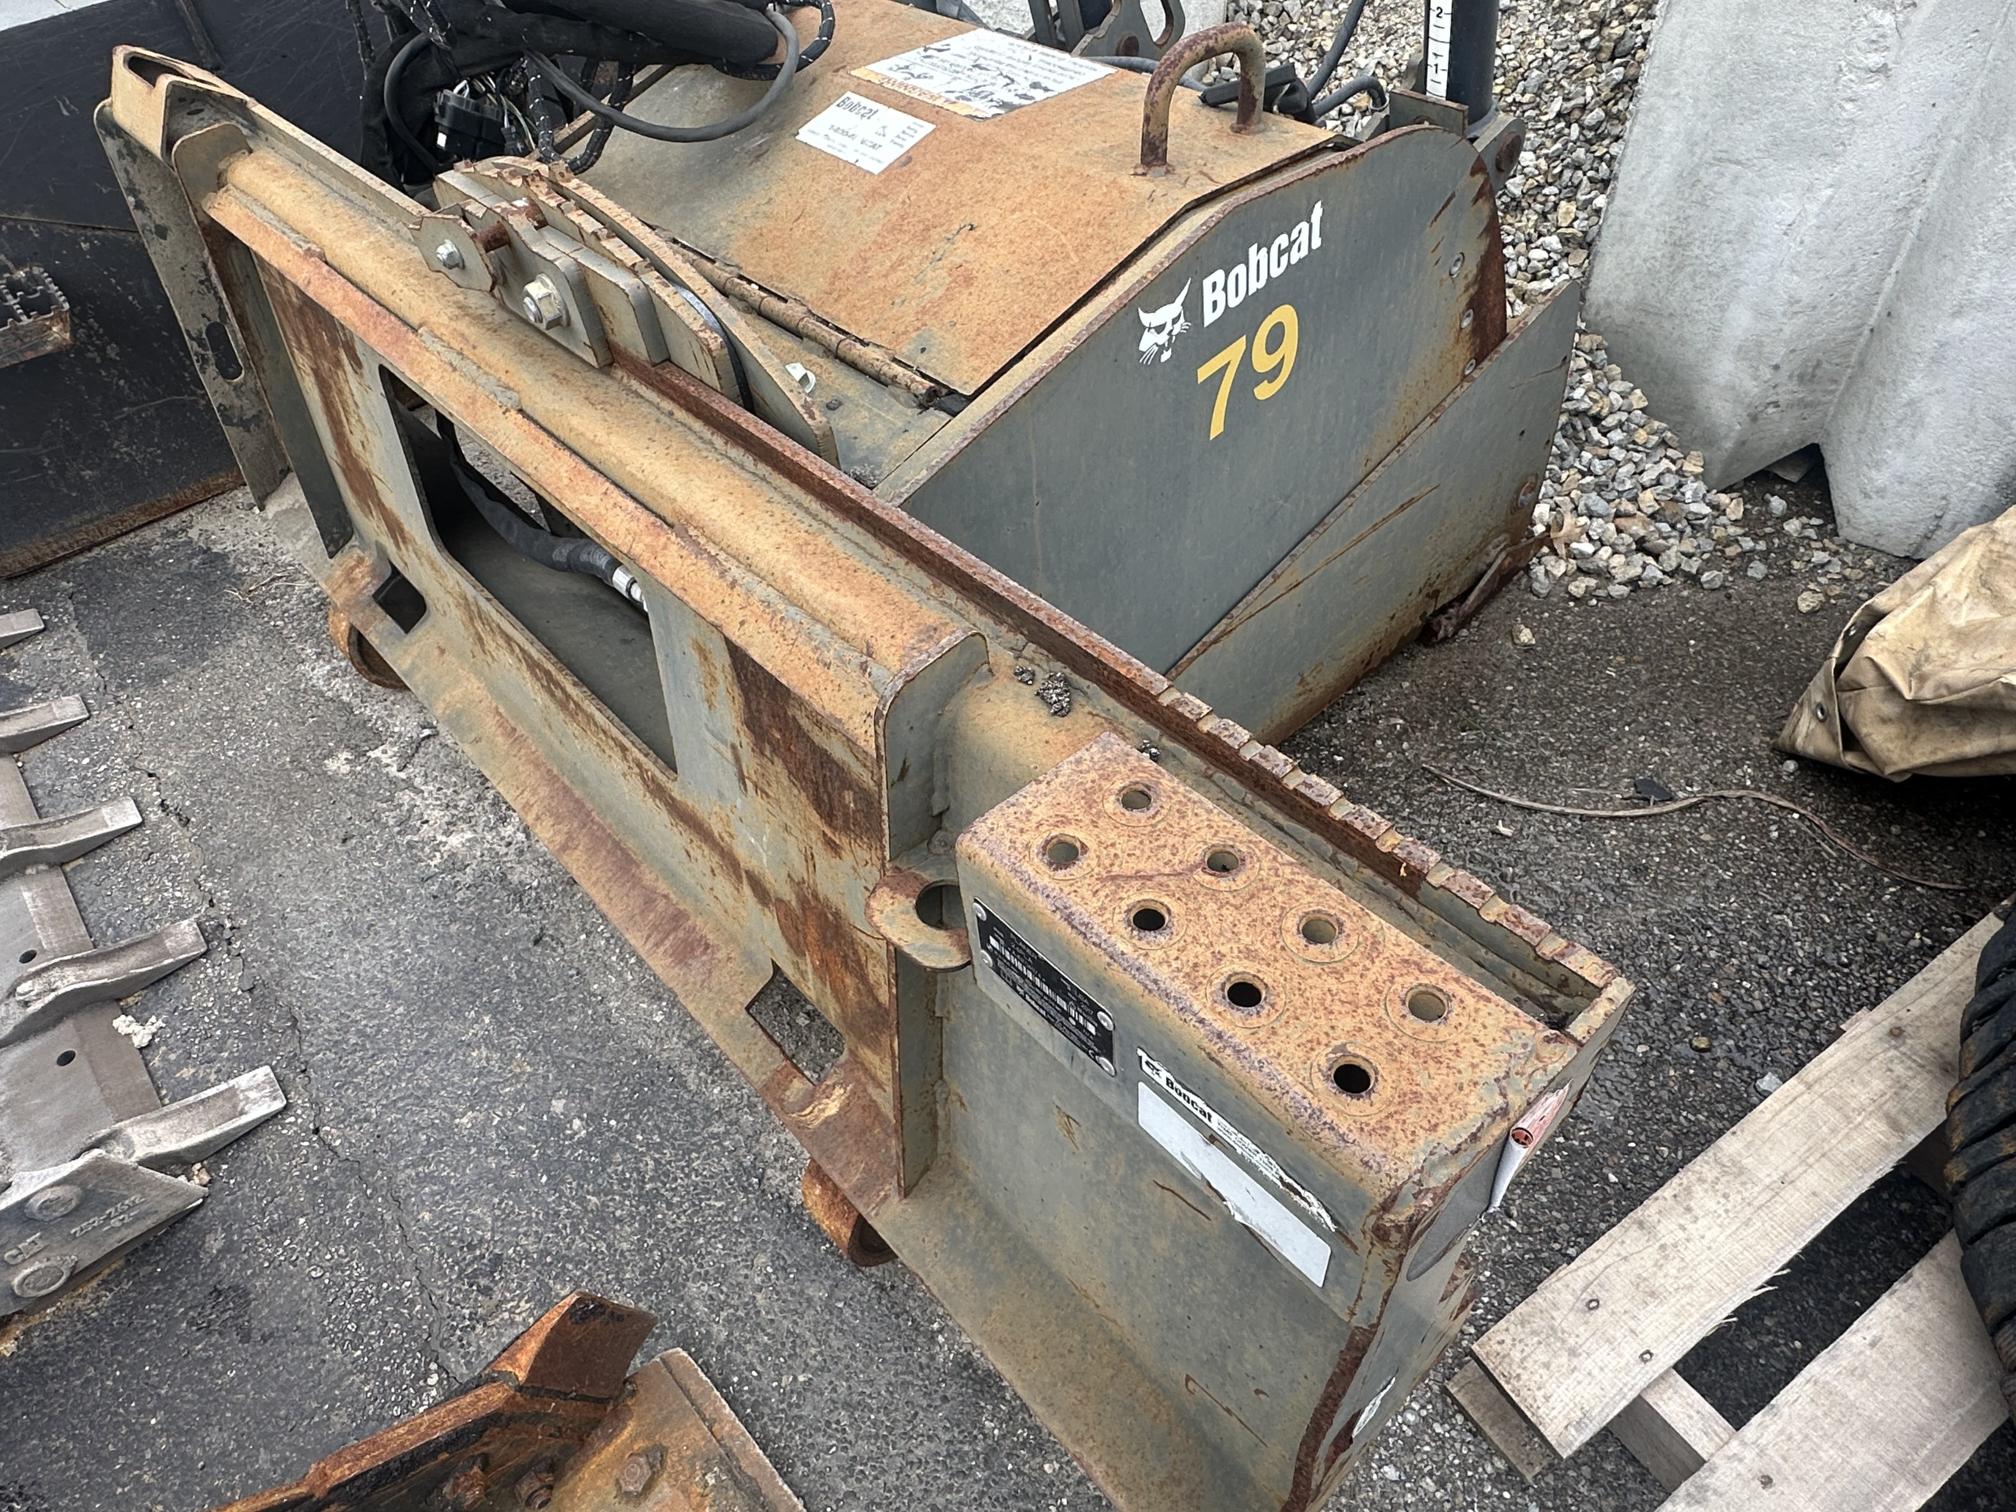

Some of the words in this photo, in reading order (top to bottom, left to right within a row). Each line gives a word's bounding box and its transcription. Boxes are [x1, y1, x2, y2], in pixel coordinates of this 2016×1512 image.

[1435, 6, 1443, 19] 2
[1202, 199, 1324, 328] Bobcat
[1196, 303, 1299, 440] 79
[4, 1232, 44, 1265] CAT
